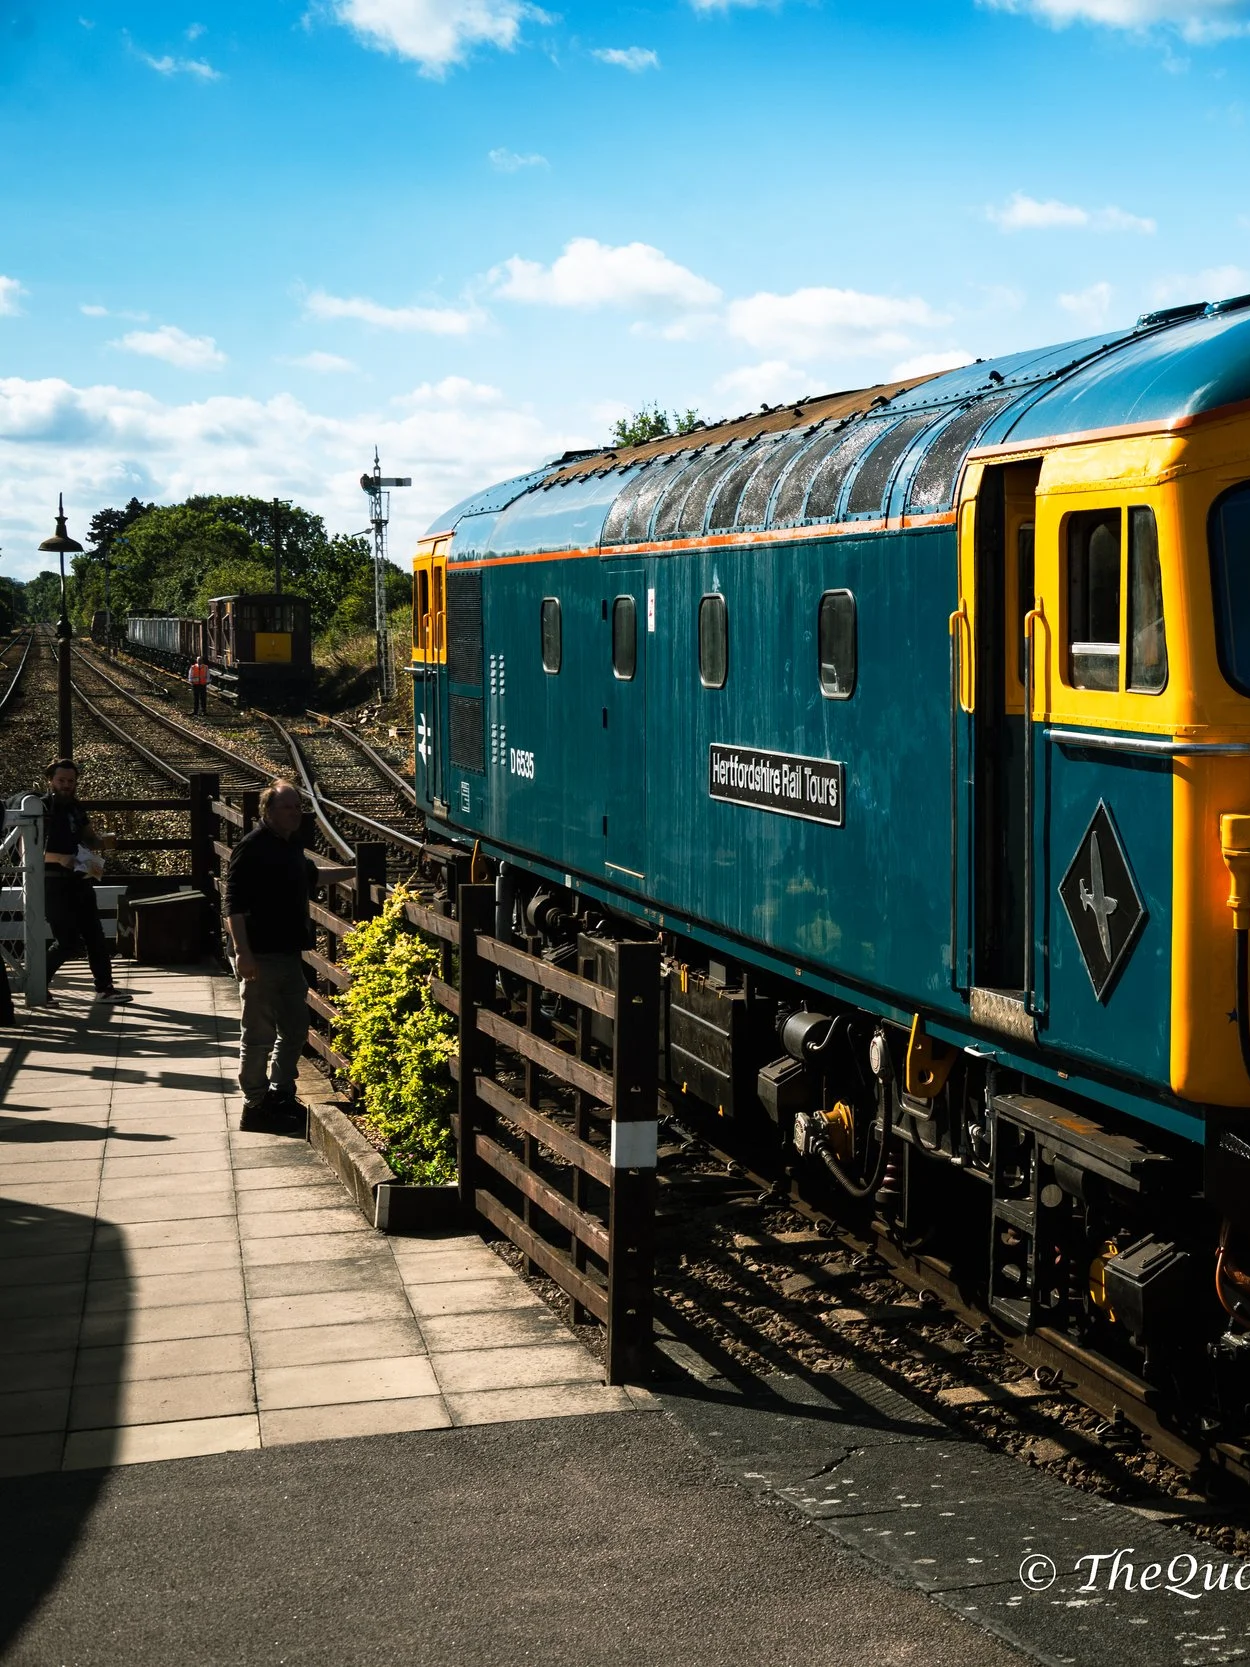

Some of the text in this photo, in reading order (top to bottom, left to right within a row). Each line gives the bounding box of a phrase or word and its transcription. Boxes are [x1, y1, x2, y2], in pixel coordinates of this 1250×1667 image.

[712, 752, 838, 807] Hertfordshire Rail Tours
